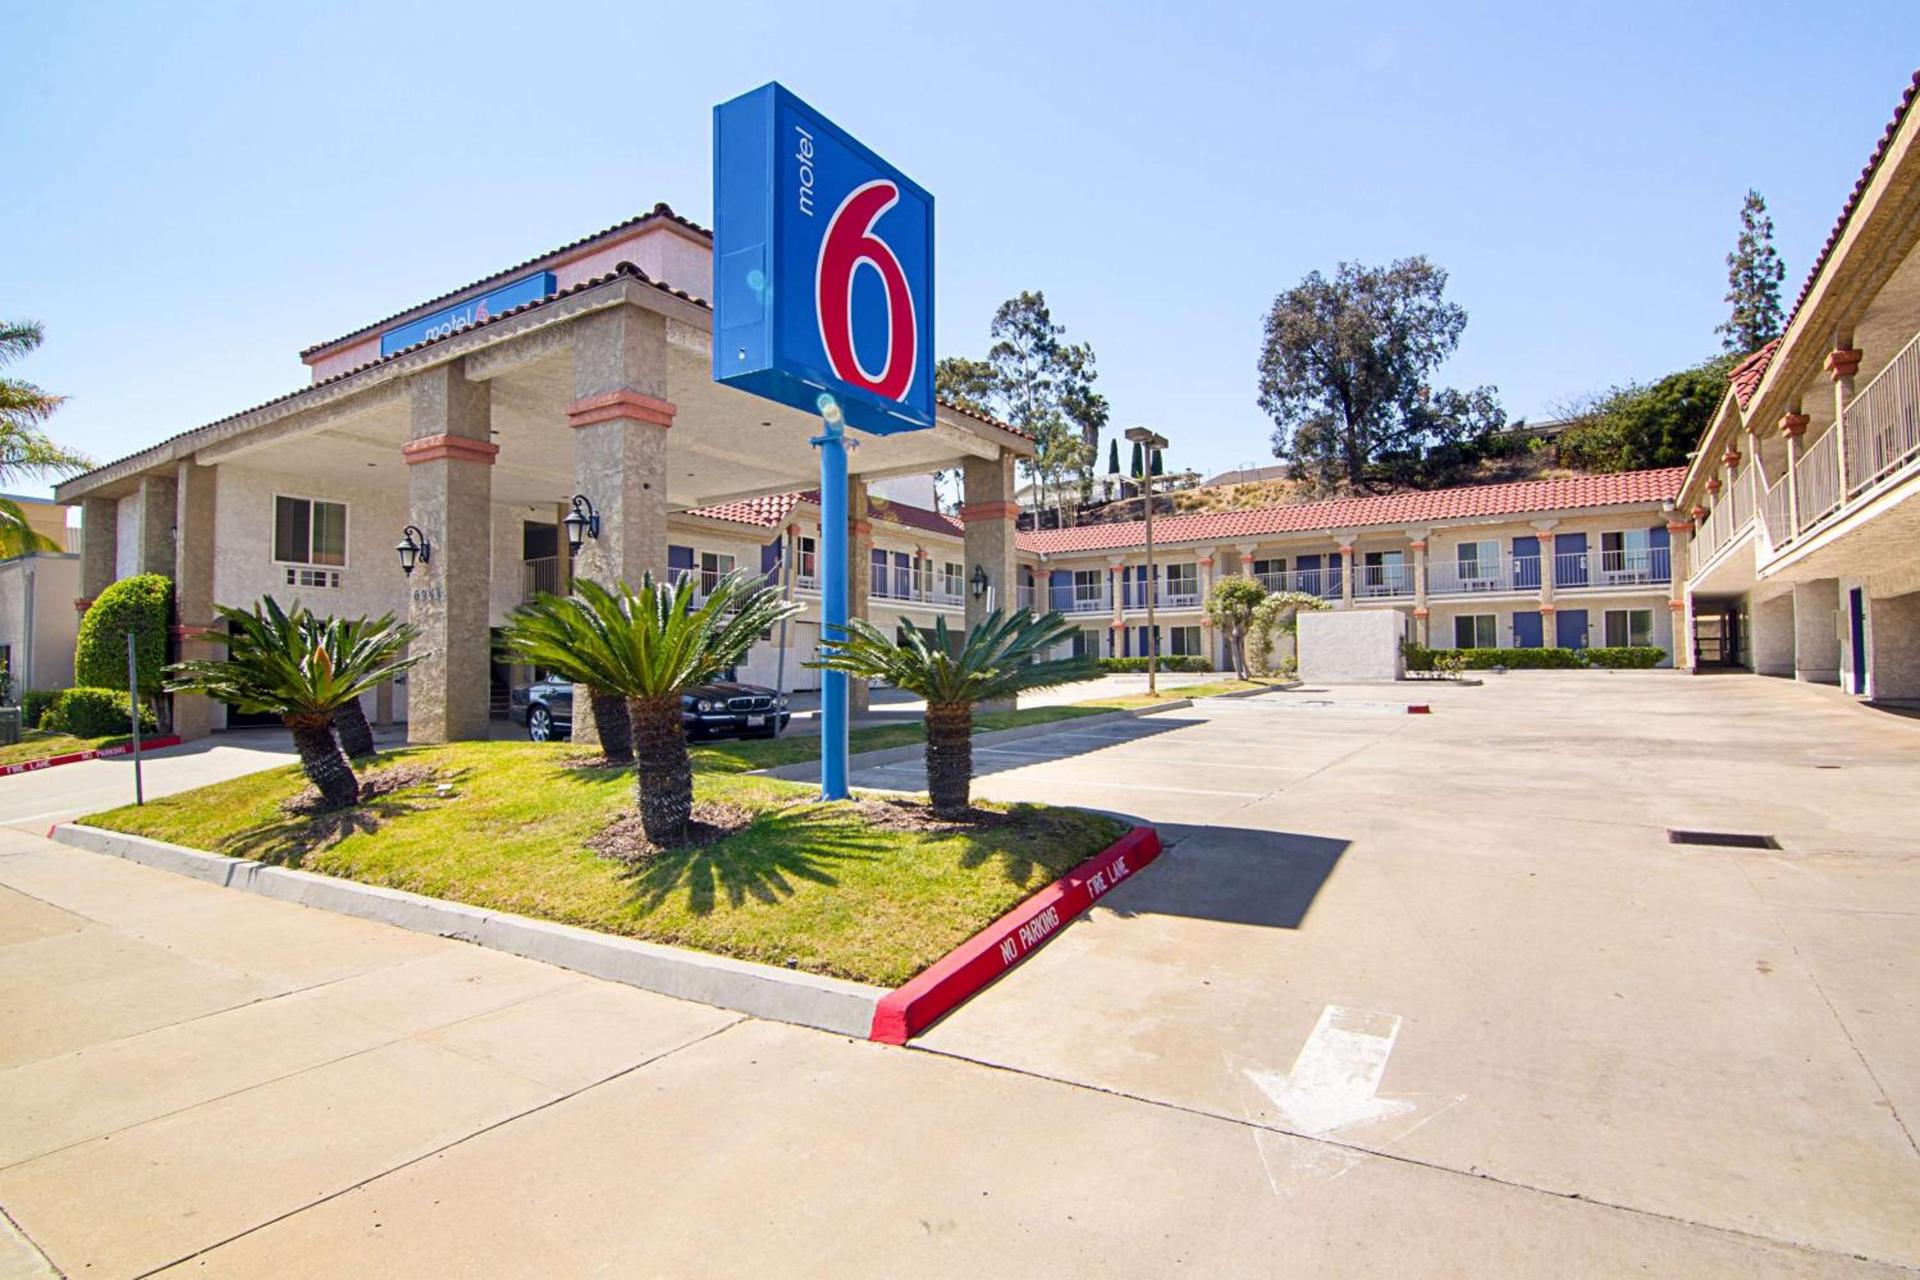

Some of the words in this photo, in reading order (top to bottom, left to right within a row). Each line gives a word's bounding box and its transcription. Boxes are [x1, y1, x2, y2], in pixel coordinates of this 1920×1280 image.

[796, 126, 814, 217] motel
[425, 308, 472, 341] motel
[815, 179, 918, 403] 6
[999, 937, 1018, 965] NO
[1018, 905, 1060, 950] PARKING
[1086, 871, 1107, 899] FIRE
[1106, 855, 1130, 882] LANE
